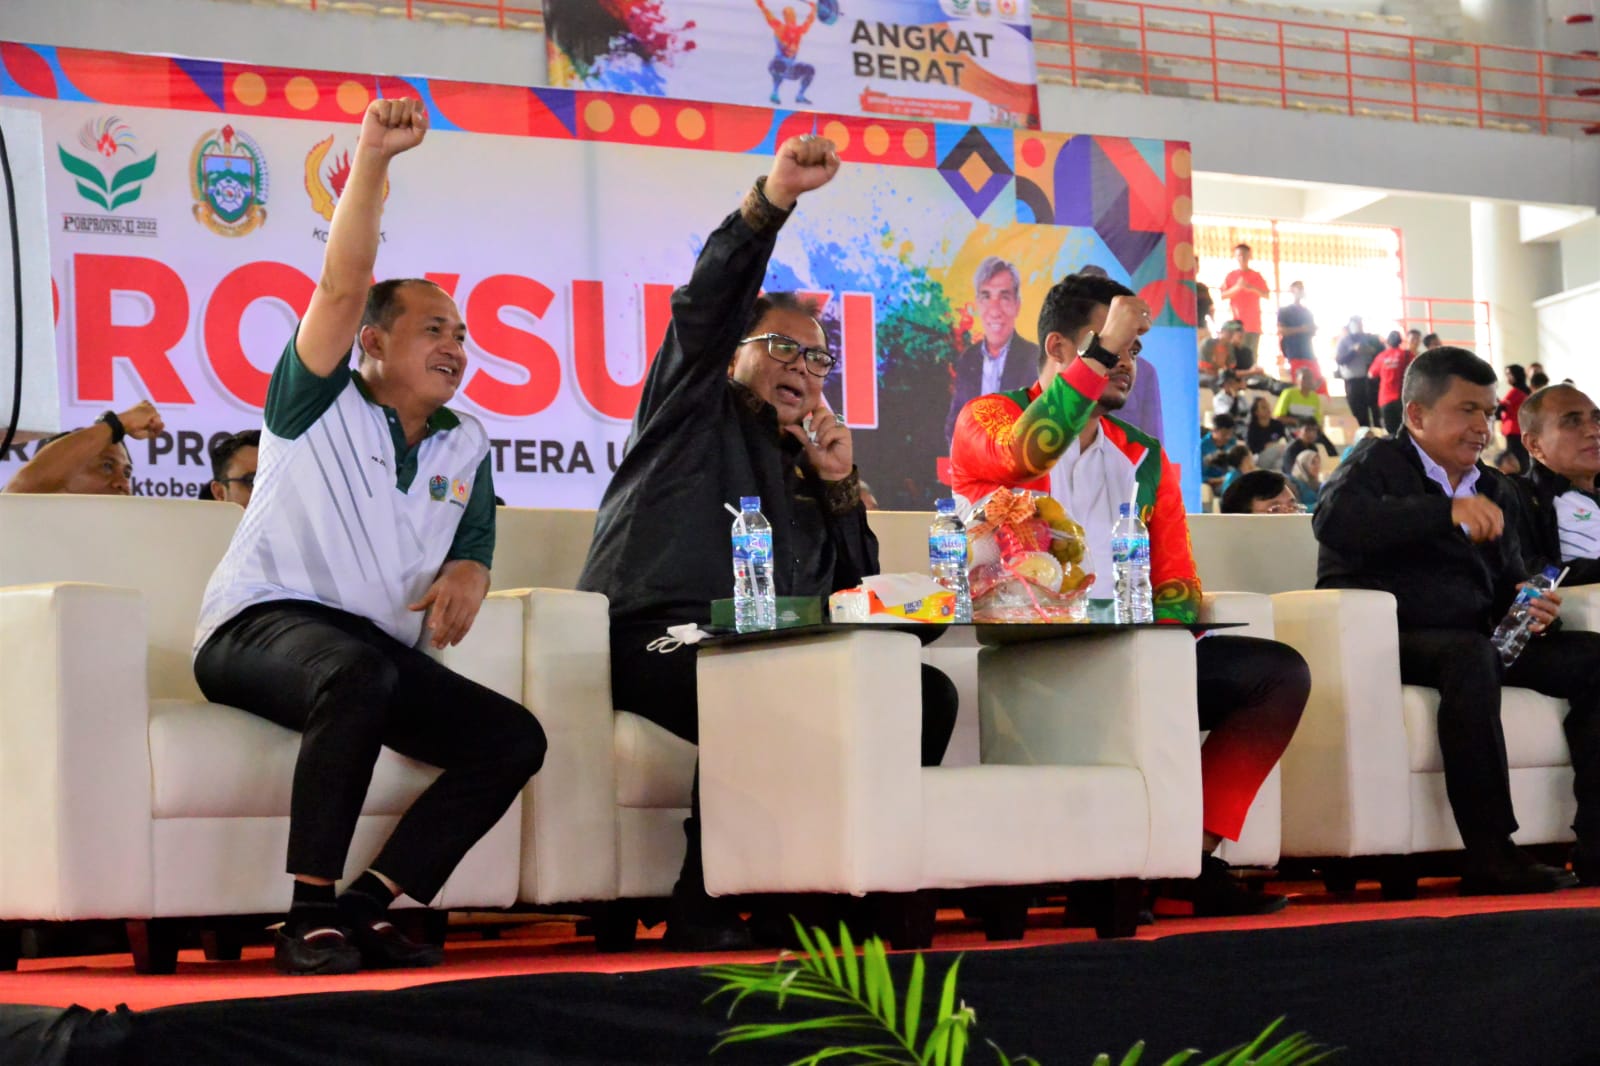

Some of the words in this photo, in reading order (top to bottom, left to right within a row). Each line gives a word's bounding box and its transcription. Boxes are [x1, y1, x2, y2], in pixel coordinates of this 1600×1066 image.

[851, 19, 993, 58] ANGKAT
[853, 51, 965, 86] BERAT
[489, 439, 595, 473] TERA
[131, 476, 205, 497] ktobe
